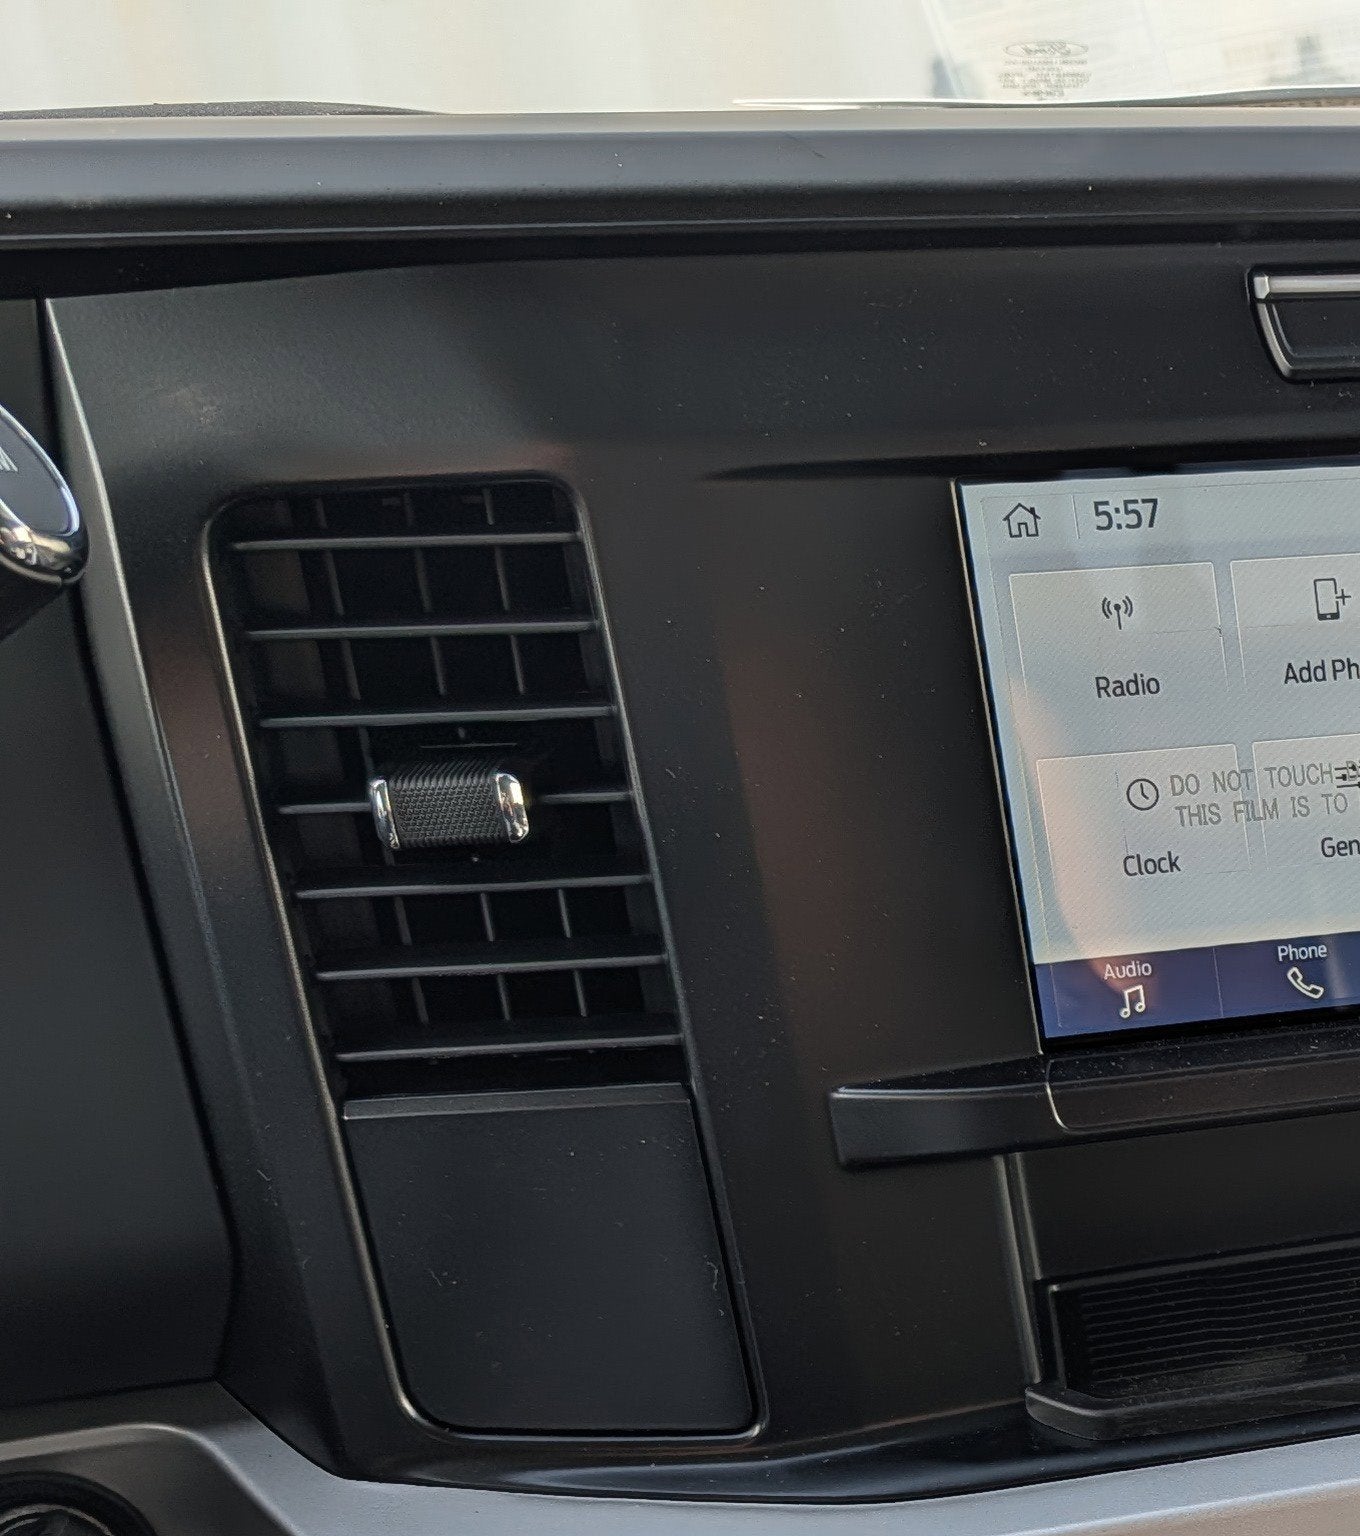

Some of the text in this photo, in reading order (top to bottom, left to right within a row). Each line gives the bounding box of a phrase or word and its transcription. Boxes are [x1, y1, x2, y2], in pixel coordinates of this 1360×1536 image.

[1094, 497, 1161, 531] 5:57
[1284, 660, 1327, 685] Add
[1095, 674, 1160, 699] Radio
[1170, 774, 1200, 798] DO
[1212, 768, 1254, 794] NOT
[1265, 763, 1334, 789] TOUCH
[1175, 803, 1221, 827] THIS
[1233, 799, 1279, 823] FILM
[1291, 795, 1310, 818] IS
[1321, 792, 1349, 815] TO
[1122, 848, 1181, 878] Clock
[1276, 941, 1328, 962] Phone
[1103, 958, 1153, 981] Audio
